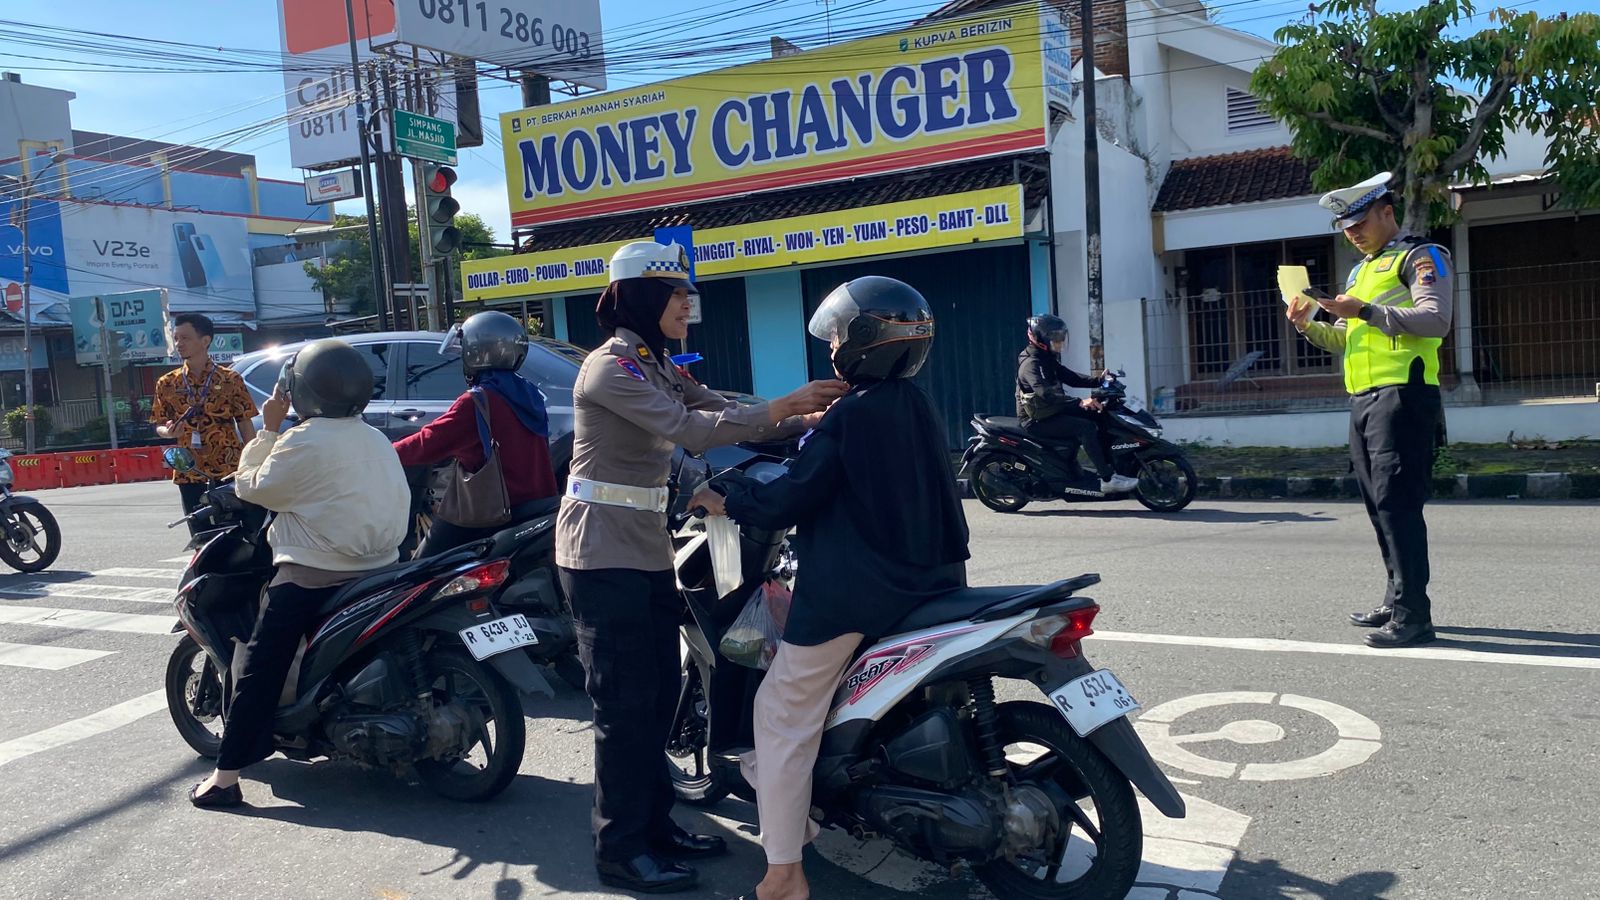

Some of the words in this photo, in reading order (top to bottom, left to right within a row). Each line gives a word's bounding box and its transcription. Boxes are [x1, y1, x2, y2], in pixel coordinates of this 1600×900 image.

[419, 0, 488, 32] 0811
[500, 7, 544, 46] 286
[551, 23, 590, 59] 003
[914, 30, 957, 49] KUPVA
[960, 18, 1013, 38] BERIZIN
[297, 67, 347, 107] Call
[300, 109, 347, 139] 0811
[518, 108, 697, 199] MONEY
[711, 48, 1018, 167] CHANGER
[526, 117, 540, 127] PT.
[541, 109, 578, 125] BERKAH
[580, 101, 621, 116] AMANAH
[623, 91, 666, 107] SYARIAH
[409, 117, 442, 133] SIMPANG
[418, 131, 445, 145] MASJID
[7, 244, 54, 256] vvo
[92, 239, 151, 258] V23e
[468, 271, 500, 289] DOLLAR
[506, 267, 529, 284] EURO
[536, 263, 568, 281] POUND
[574, 258, 605, 277] DINAR
[743, 236, 775, 256] RIYAL
[785, 231, 814, 250] WON
[822, 227, 845, 246] YEN
[854, 221, 887, 242] YUAN
[896, 215, 928, 236] PESO
[939, 208, 974, 230] BAHT
[985, 204, 1009, 224] DLL
[111, 261, 132, 270] Every
[133, 262, 159, 270] Portrait
[110, 300, 144, 318] DAP
[466, 630, 478, 644] R
[480, 621, 509, 637] 6438
[513, 613, 528, 629] DJ
[1055, 694, 1074, 713] R
[1082, 677, 1113, 699] 4534
